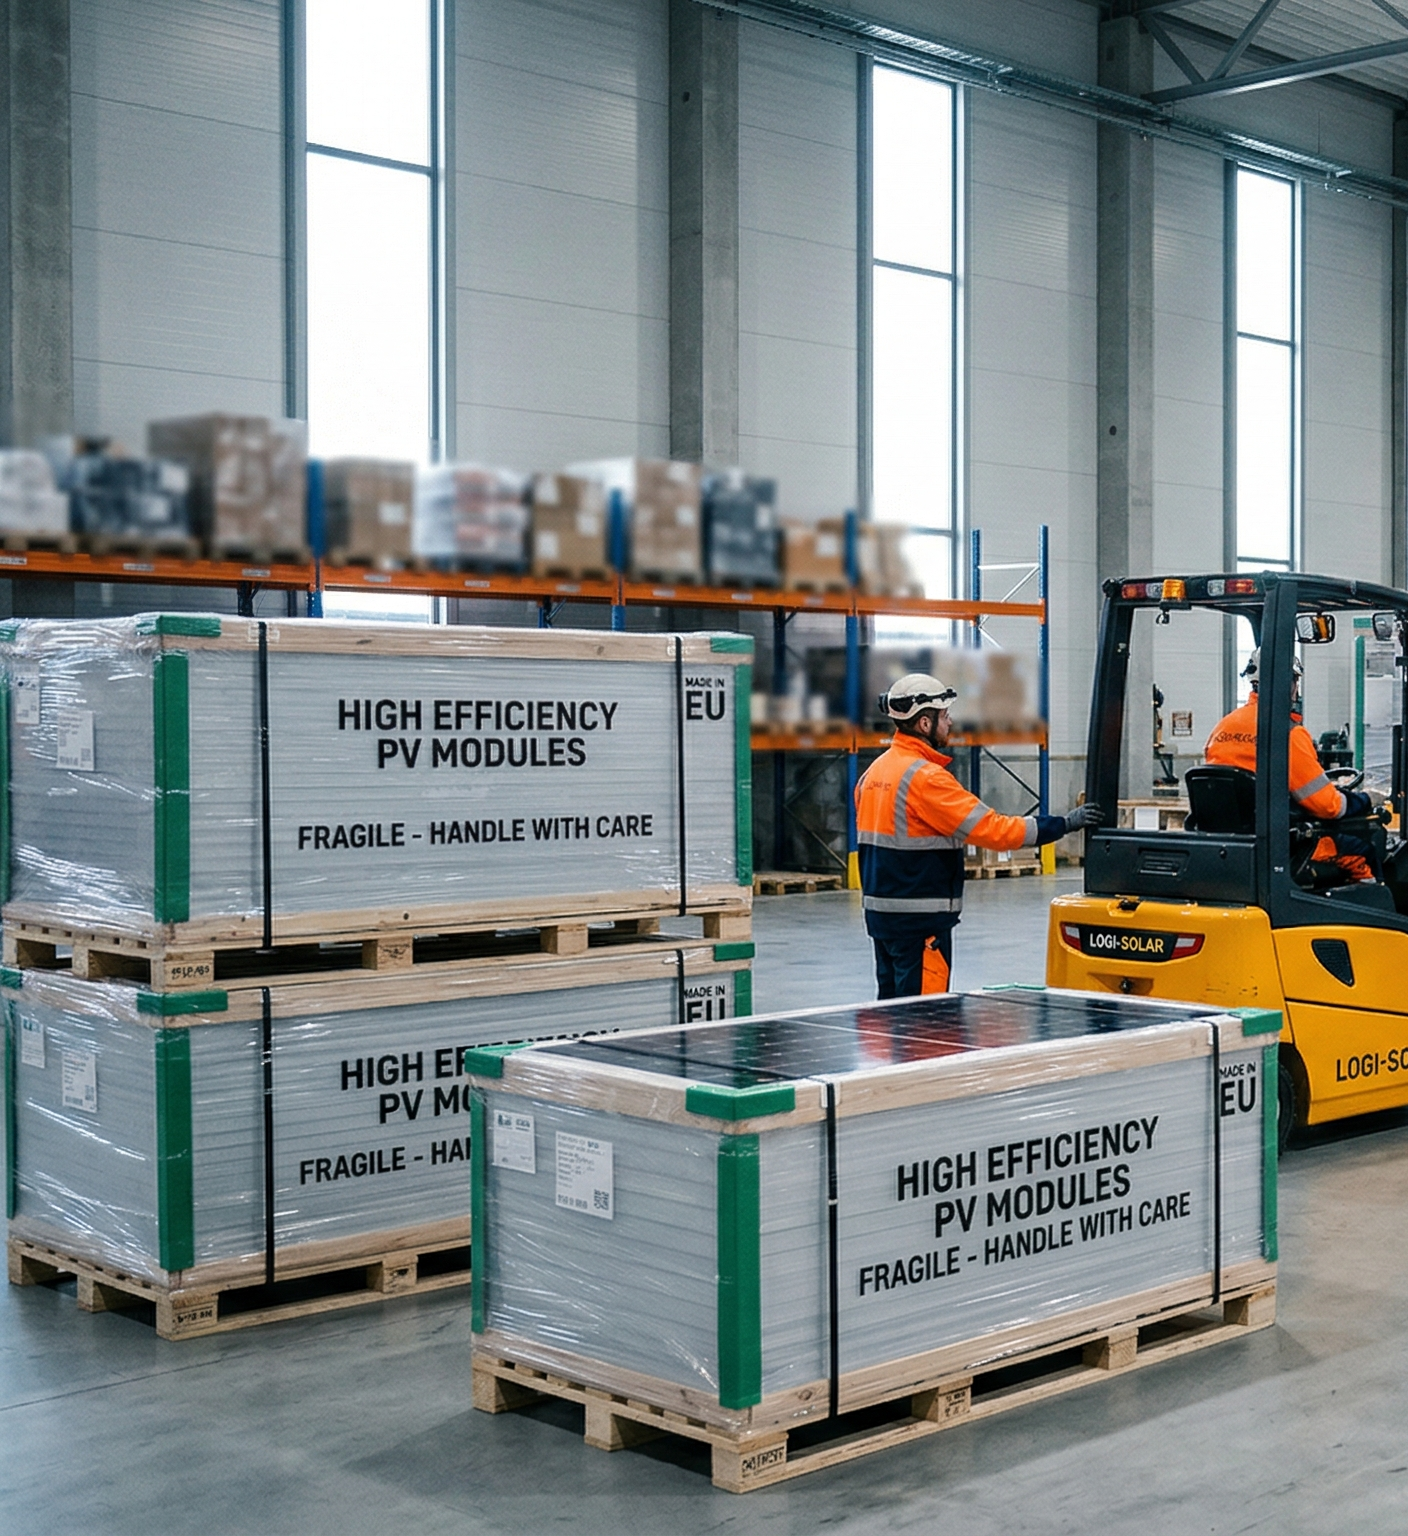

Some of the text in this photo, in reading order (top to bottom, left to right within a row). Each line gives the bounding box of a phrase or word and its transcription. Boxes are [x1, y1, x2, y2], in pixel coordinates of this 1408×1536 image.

[338, 699, 618, 732] HIGH EFFICIENCY
[686, 690, 725, 721] EU
[377, 738, 587, 769] PV MODULES
[298, 822, 405, 850] FRAGILE
[430, 818, 526, 845] HANDLE
[532, 815, 591, 841] WITH
[595, 813, 654, 839] CARE
[1090, 933, 1164, 953] LOGI-SOLAR
[715, 985, 725, 995] IN
[341, 1051, 423, 1090] HIGH
[1247, 1062, 1256, 1074] IN
[379, 1088, 424, 1124] PV
[1221, 1076, 1256, 1117] EU
[299, 1146, 406, 1185] FRAGILE
[897, 1116, 1160, 1202] HIGH EFFICIENCY
[934, 1164, 1132, 1238] PV MODULES
[859, 1248, 960, 1296] FRAGILE
[984, 1227, 1073, 1267] HANDLE
[1080, 1209, 1134, 1246] WITH
[1138, 1191, 1191, 1229] CARE
